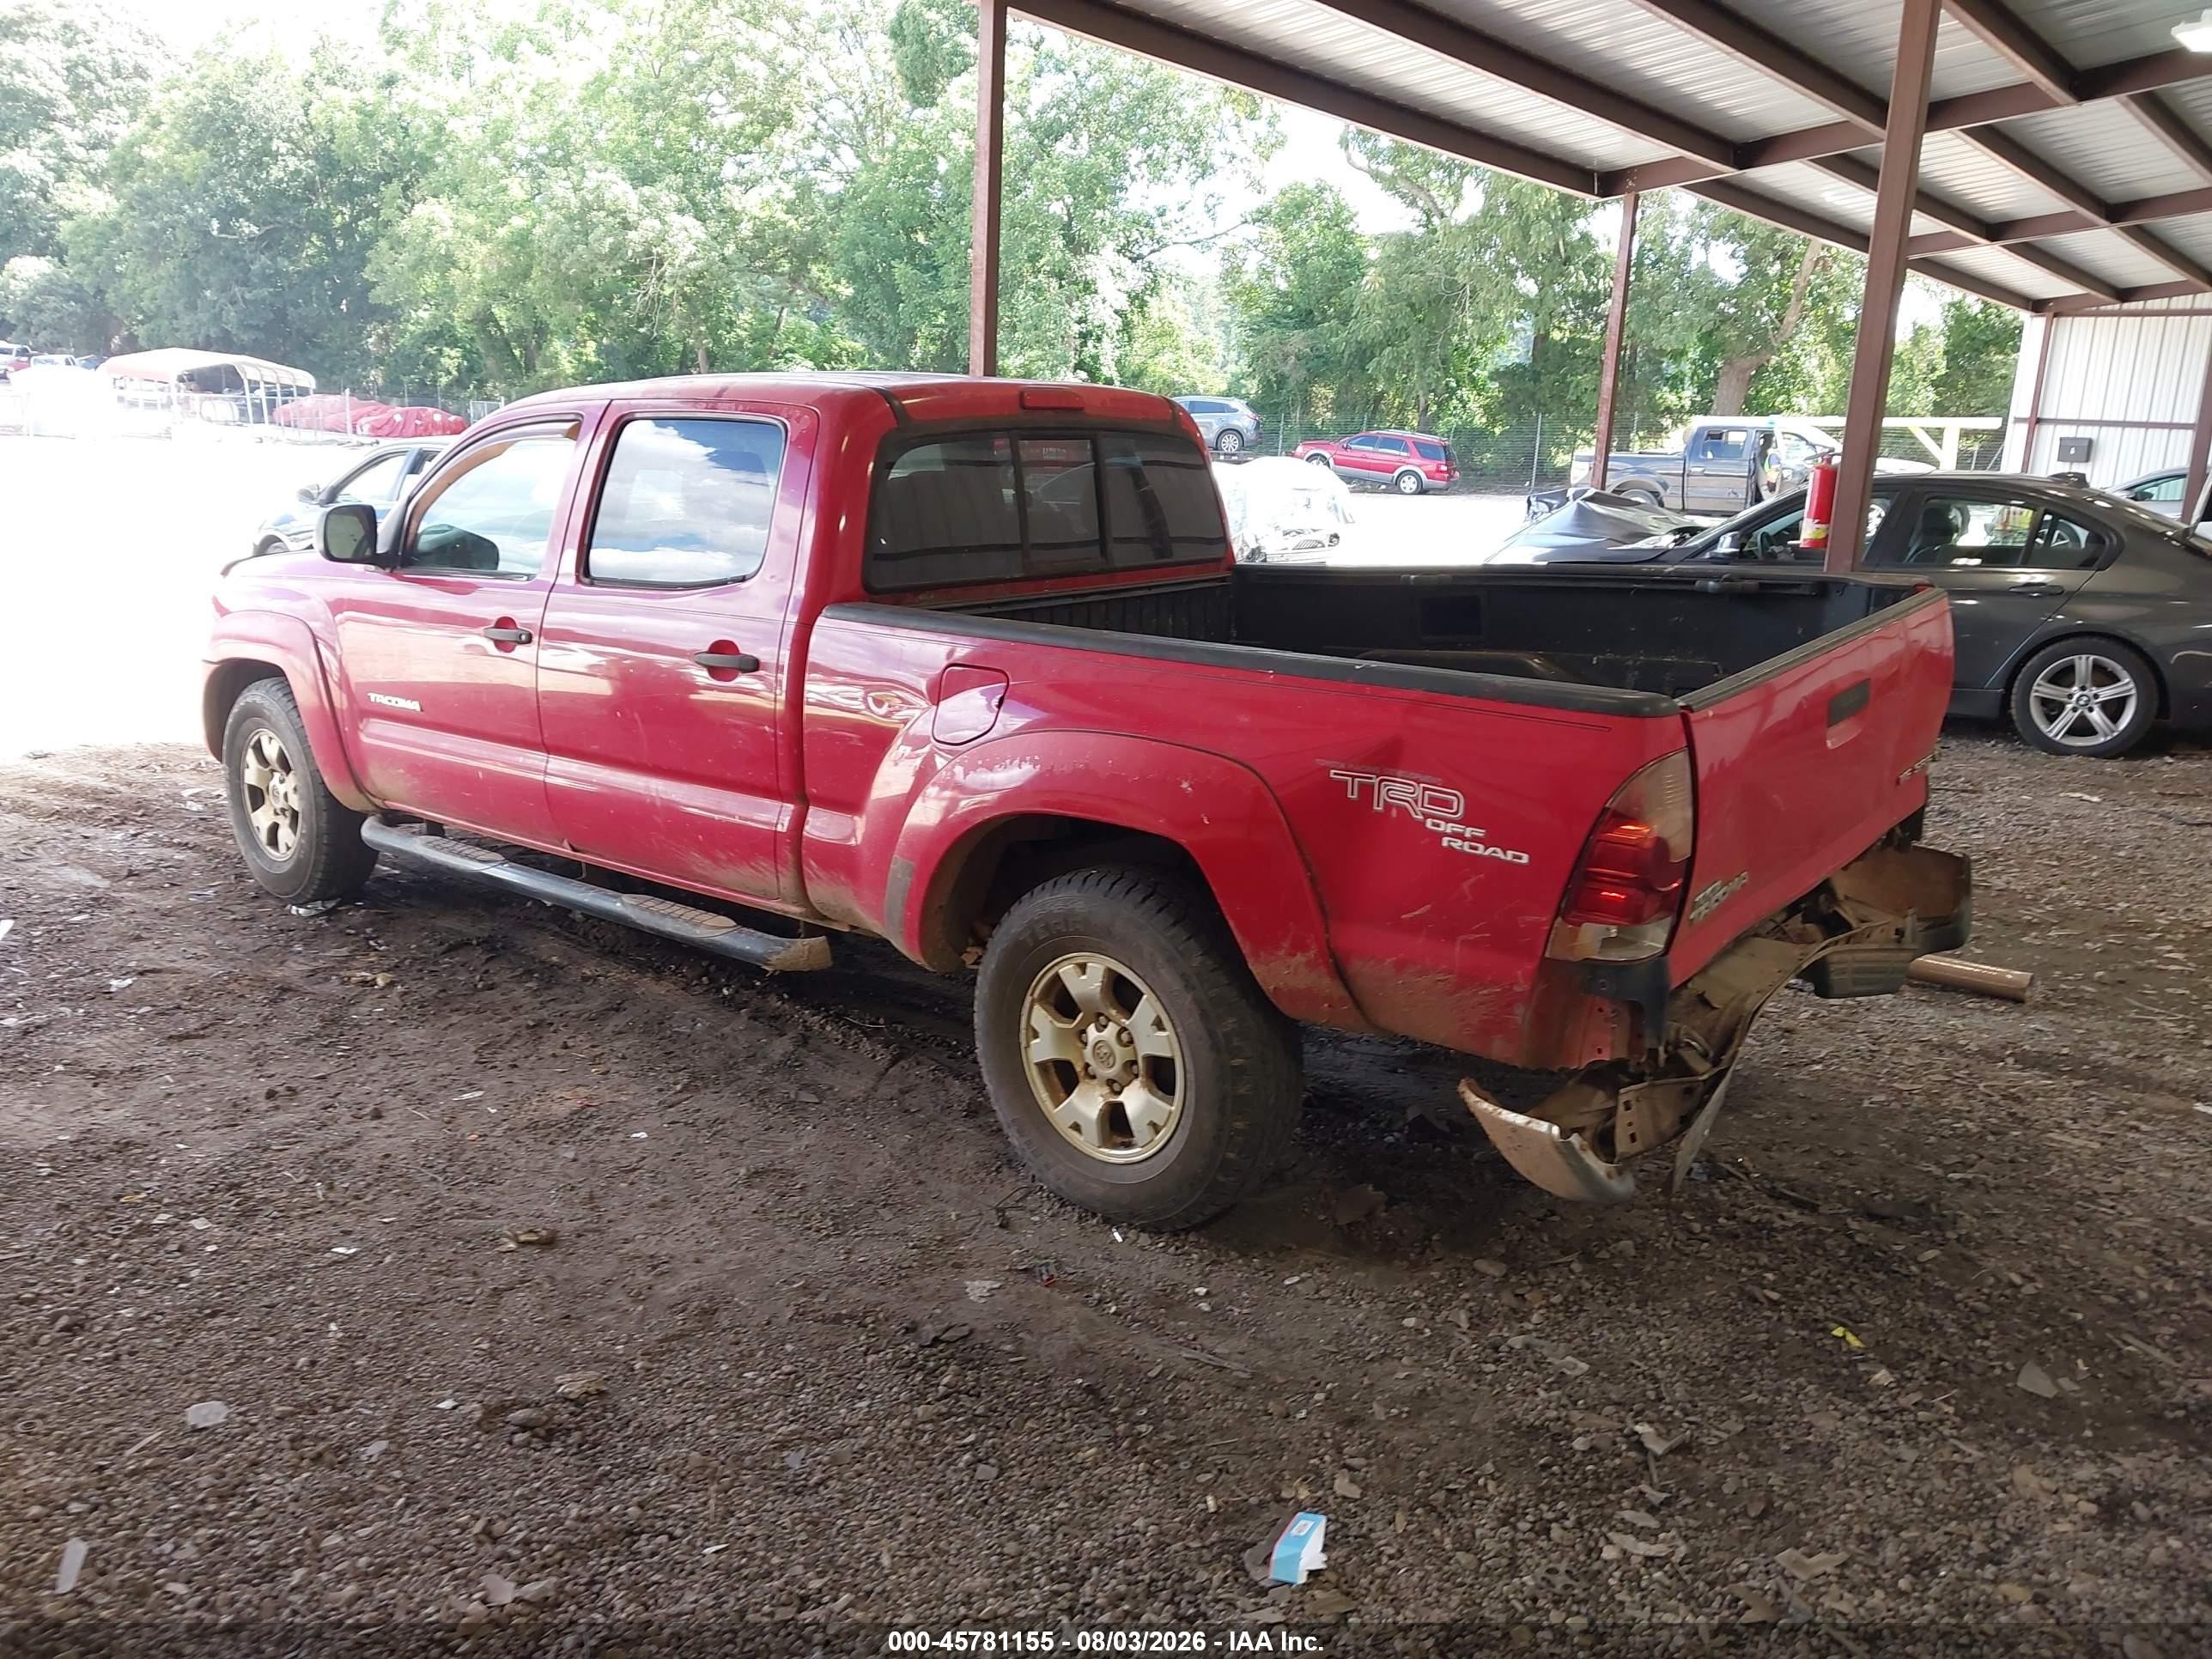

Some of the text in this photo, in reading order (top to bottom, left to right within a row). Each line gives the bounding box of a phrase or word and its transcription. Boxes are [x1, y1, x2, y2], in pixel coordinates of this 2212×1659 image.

[1330, 769, 1465, 819] TRD
[1425, 817, 1487, 838] OFF
[1441, 836, 1531, 865] ROAD
